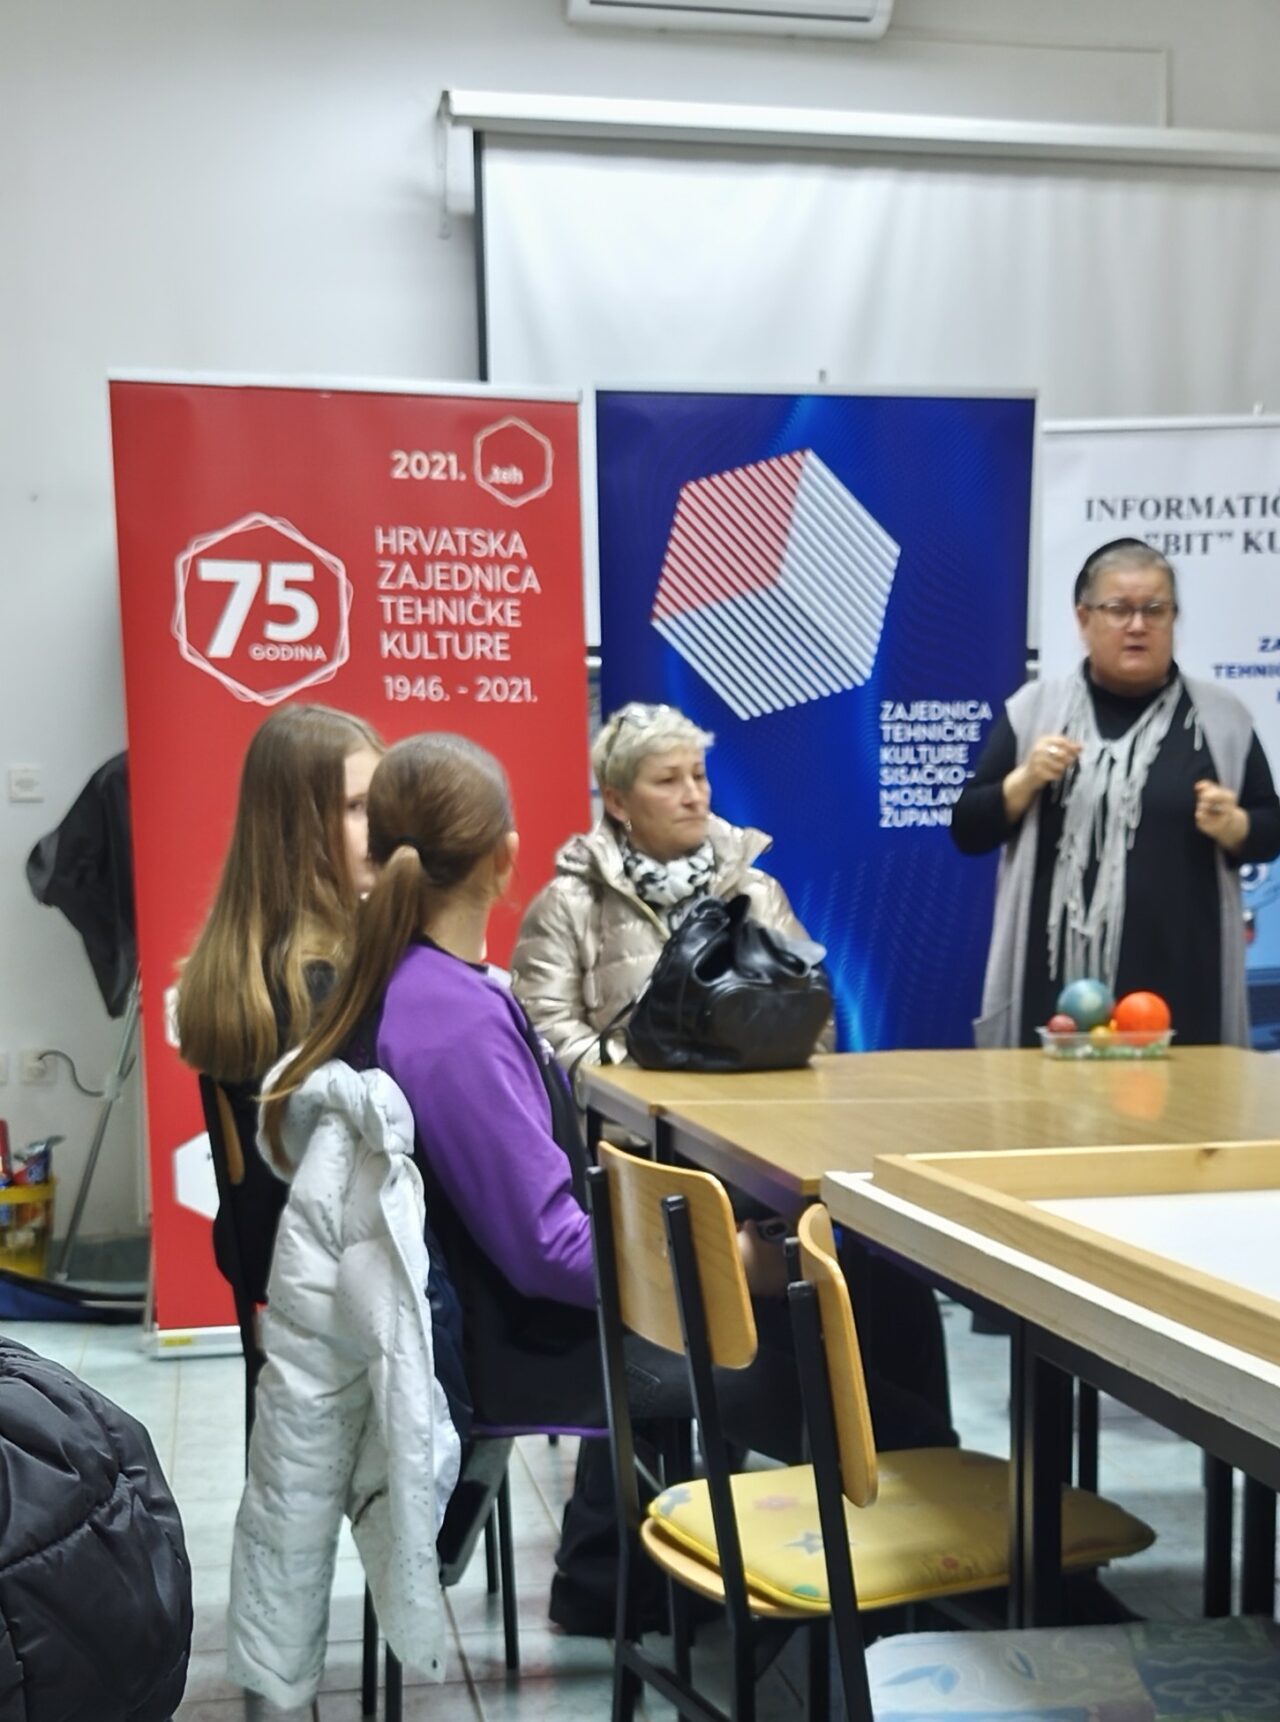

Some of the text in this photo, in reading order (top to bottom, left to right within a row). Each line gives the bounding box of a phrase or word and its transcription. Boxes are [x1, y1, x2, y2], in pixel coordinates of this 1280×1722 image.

[390, 449, 467, 481] 2021.
[375, 526, 528, 559] HRVATSKA
[376, 560, 542, 594] ZAJEDNICA
[197, 559, 319, 659] 75
[379, 592, 522, 628] TEHNIČKE
[249, 644, 327, 663] GODINA
[380, 630, 511, 661] KULTURE
[384, 674, 450, 702] 1946.
[474, 676, 538, 703] 2021.
[880, 700, 993, 721] ZAJEDNICA
[880, 721, 981, 743] TEHNIČKE
[880, 744, 969, 765] KULTURE
